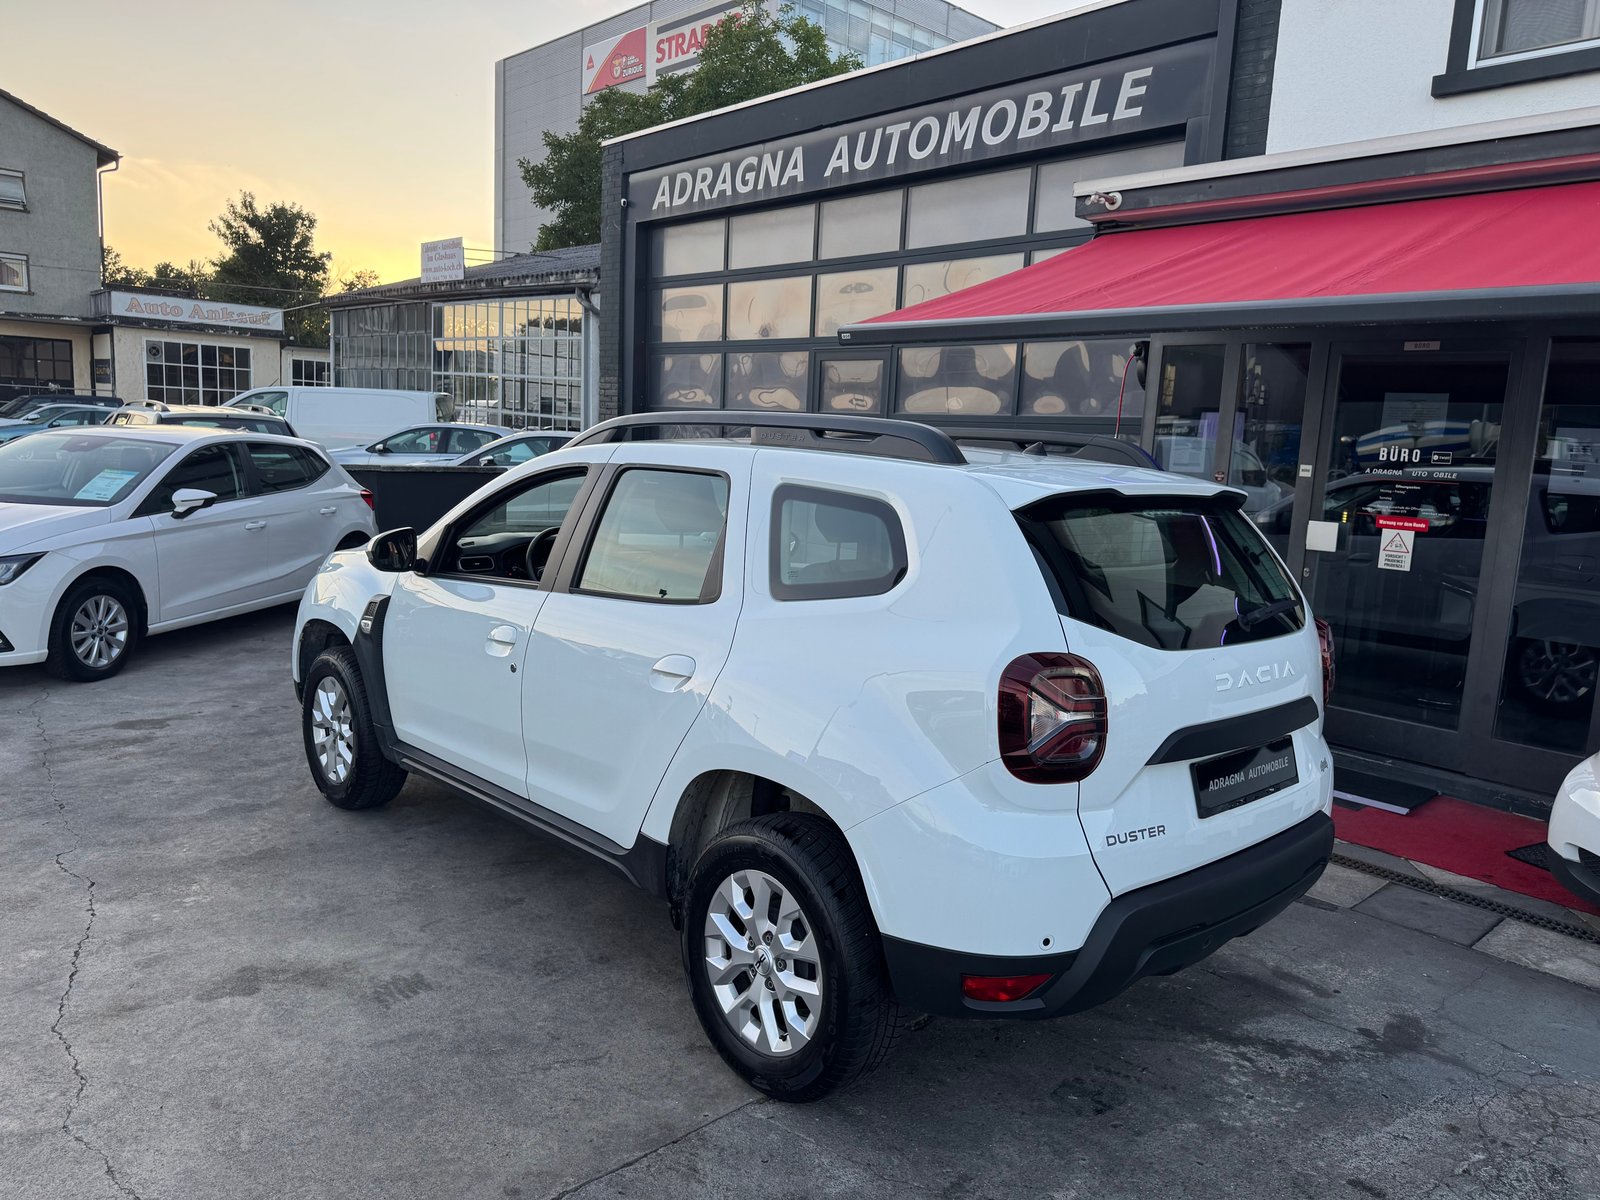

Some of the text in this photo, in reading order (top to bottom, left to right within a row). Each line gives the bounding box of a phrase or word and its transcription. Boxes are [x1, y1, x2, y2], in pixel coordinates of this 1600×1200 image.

[651, 66, 1153, 211] ADRAGNA AUTOMOBILE
[125, 297, 183, 317] Auto
[760, 431, 806, 442] DUSTER
[1379, 446, 1421, 462] BÜRO
[1379, 519, 1396, 527] Warnung
[1215, 661, 1295, 692] DACIA
[1208, 756, 1289, 792] ADRAGNA AUTOMOBILE
[1105, 824, 1166, 847] DUSTER
